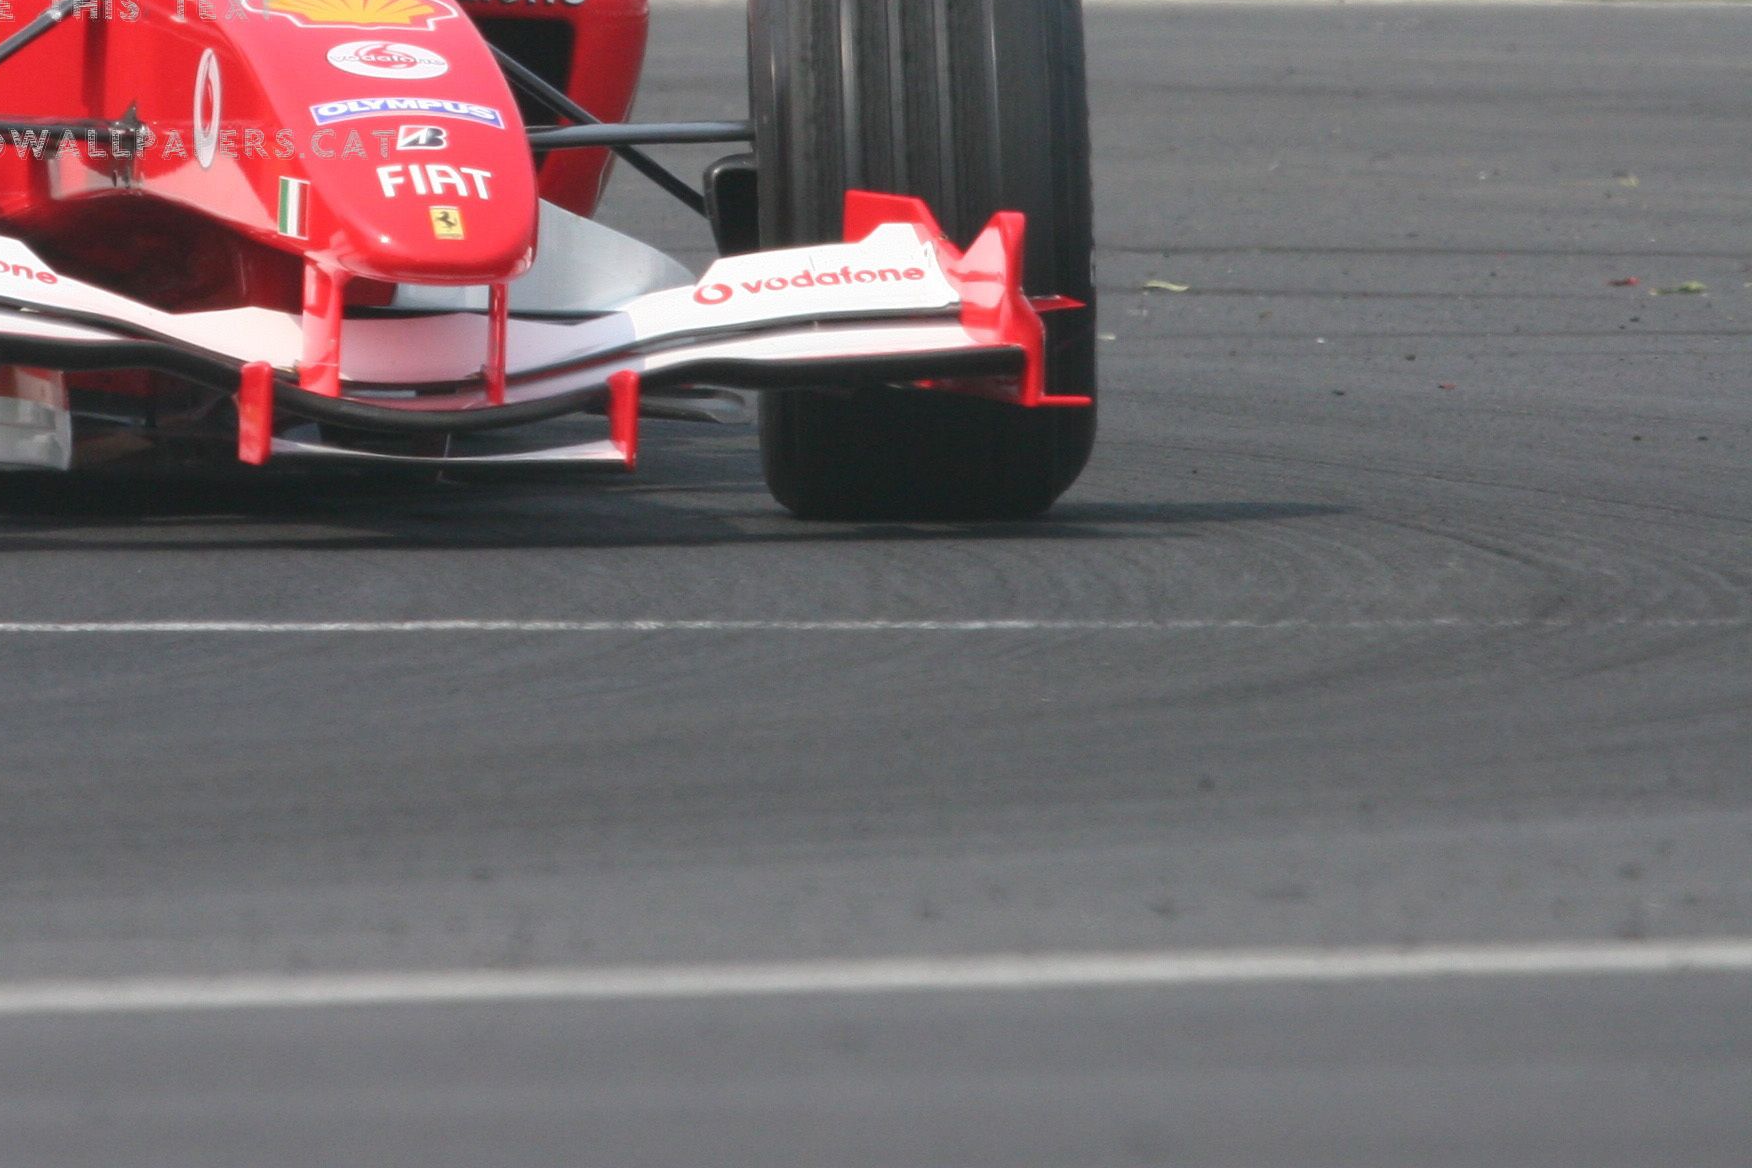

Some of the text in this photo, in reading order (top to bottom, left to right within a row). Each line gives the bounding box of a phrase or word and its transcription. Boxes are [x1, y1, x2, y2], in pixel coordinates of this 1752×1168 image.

[316, 98, 497, 121] OLYMPUS
[375, 163, 493, 201] FIAT
[740, 265, 926, 295] vodafone
